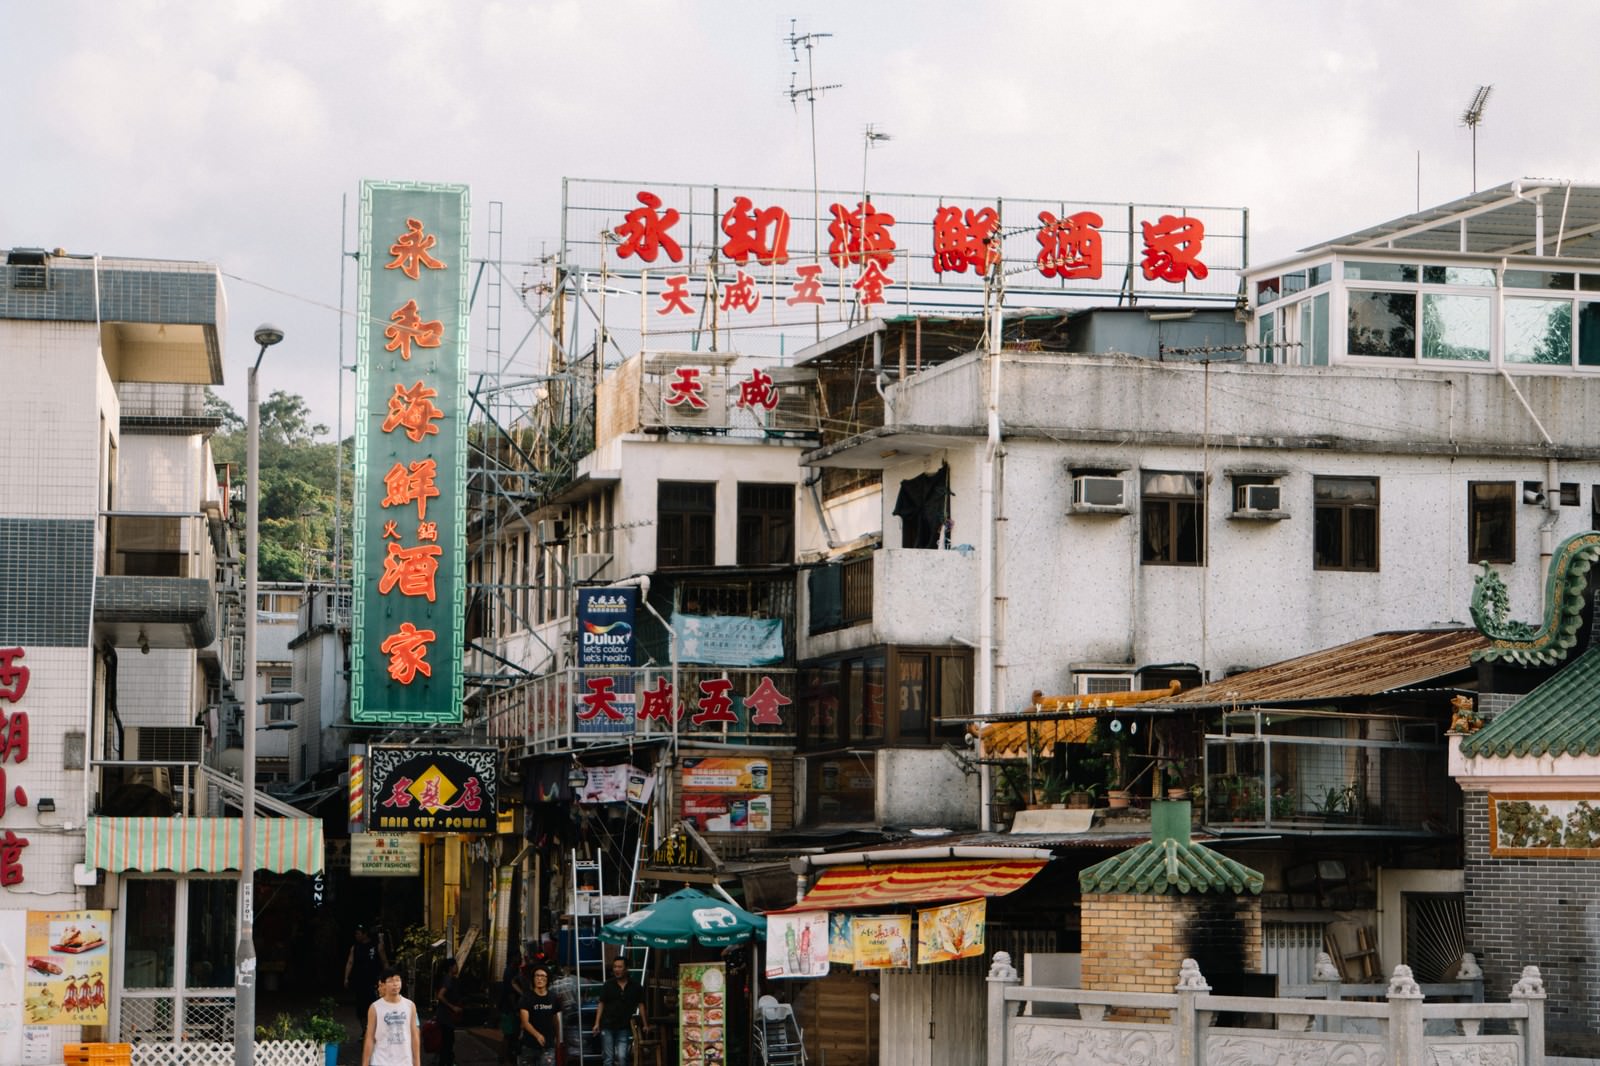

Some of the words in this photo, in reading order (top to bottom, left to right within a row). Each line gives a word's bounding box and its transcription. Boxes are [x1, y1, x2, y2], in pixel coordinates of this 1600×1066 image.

[614, 190, 1209, 284] 永和海鮮酒家
[657, 262, 894, 316] 天成五金
[664, 367, 780, 411] 天成
[379, 218, 447, 686] 永和海鮮酒家
[583, 631, 626, 645] Dulux
[583, 645, 601, 654] let's
[602, 645, 629, 654] colour
[583, 654, 601, 662] let's
[602, 654, 631, 662] health
[577, 676, 792, 727] 天成五金
[380, 816, 409, 828] HAIR
[413, 816, 435, 828] CUT
[445, 816, 487, 828] POWER
